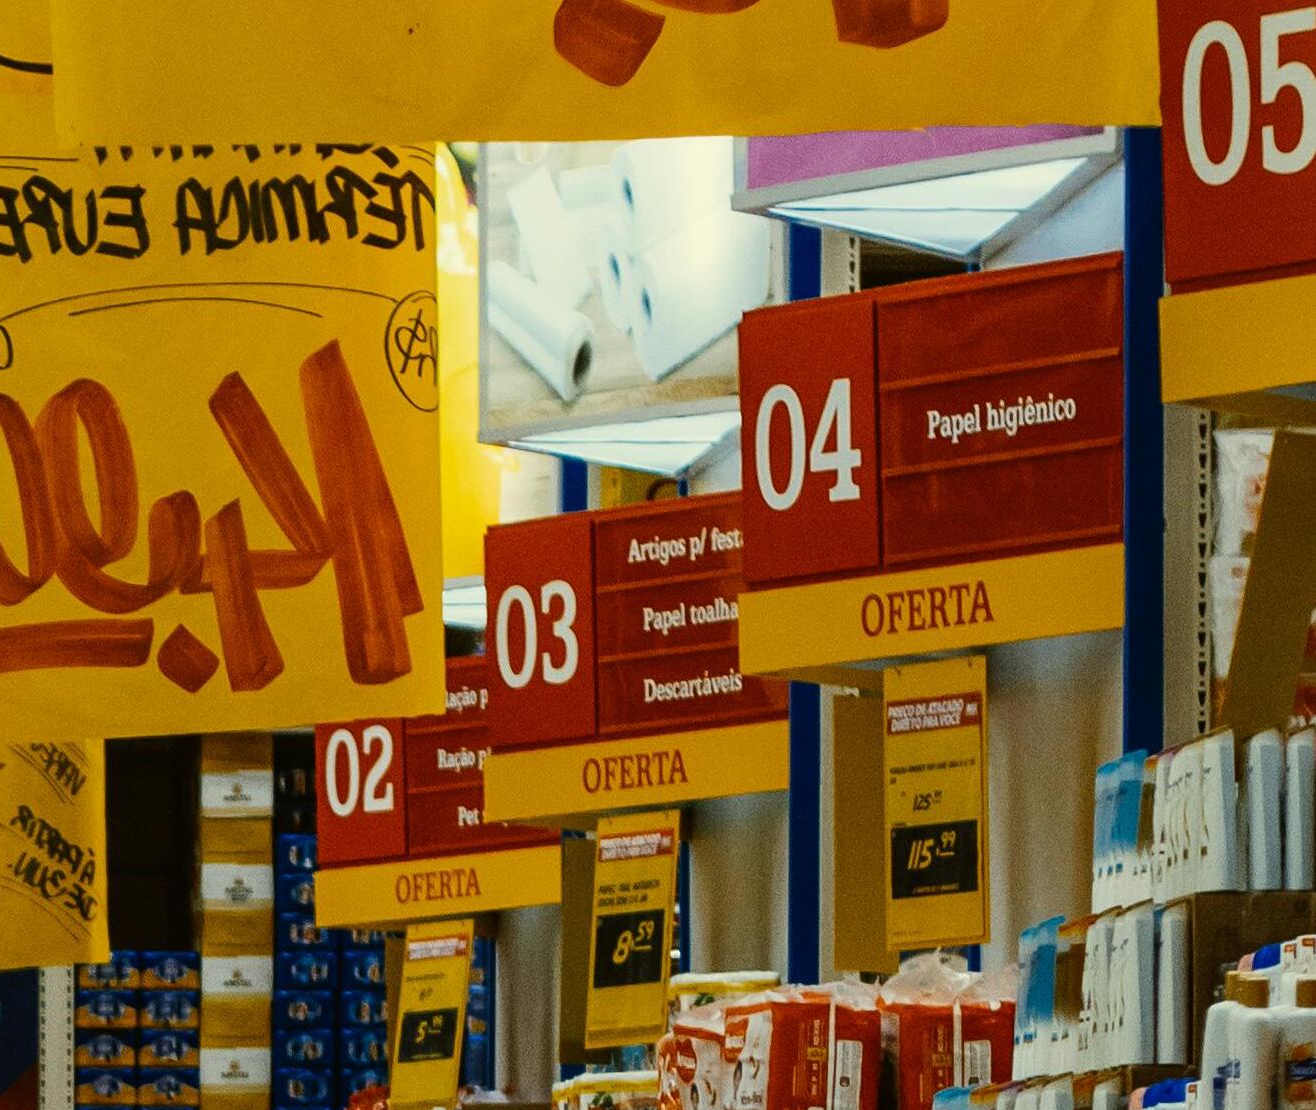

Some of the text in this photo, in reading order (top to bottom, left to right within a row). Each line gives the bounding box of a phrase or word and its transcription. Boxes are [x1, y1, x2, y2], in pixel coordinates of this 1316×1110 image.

[1182, 6, 1316, 187] 05
[926, 392, 1077, 445] Papel higiênico
[754, 377, 862, 512] 04
[627, 527, 744, 566] Artigos p/ fest
[642, 598, 739, 634] Papel toalha
[860, 579, 995, 638] OFERTA
[495, 579, 580, 690] 03
[445, 686, 479, 713] ação
[643, 667, 744, 703] Descartáveis
[324, 724, 396, 818] 02
[437, 749, 476, 773] Ração
[581, 749, 689, 794] OFERTA
[906, 831, 958, 873] 115,99
[394, 867, 483, 906] OFERTA
[612, 920, 656, 967] 8,59
